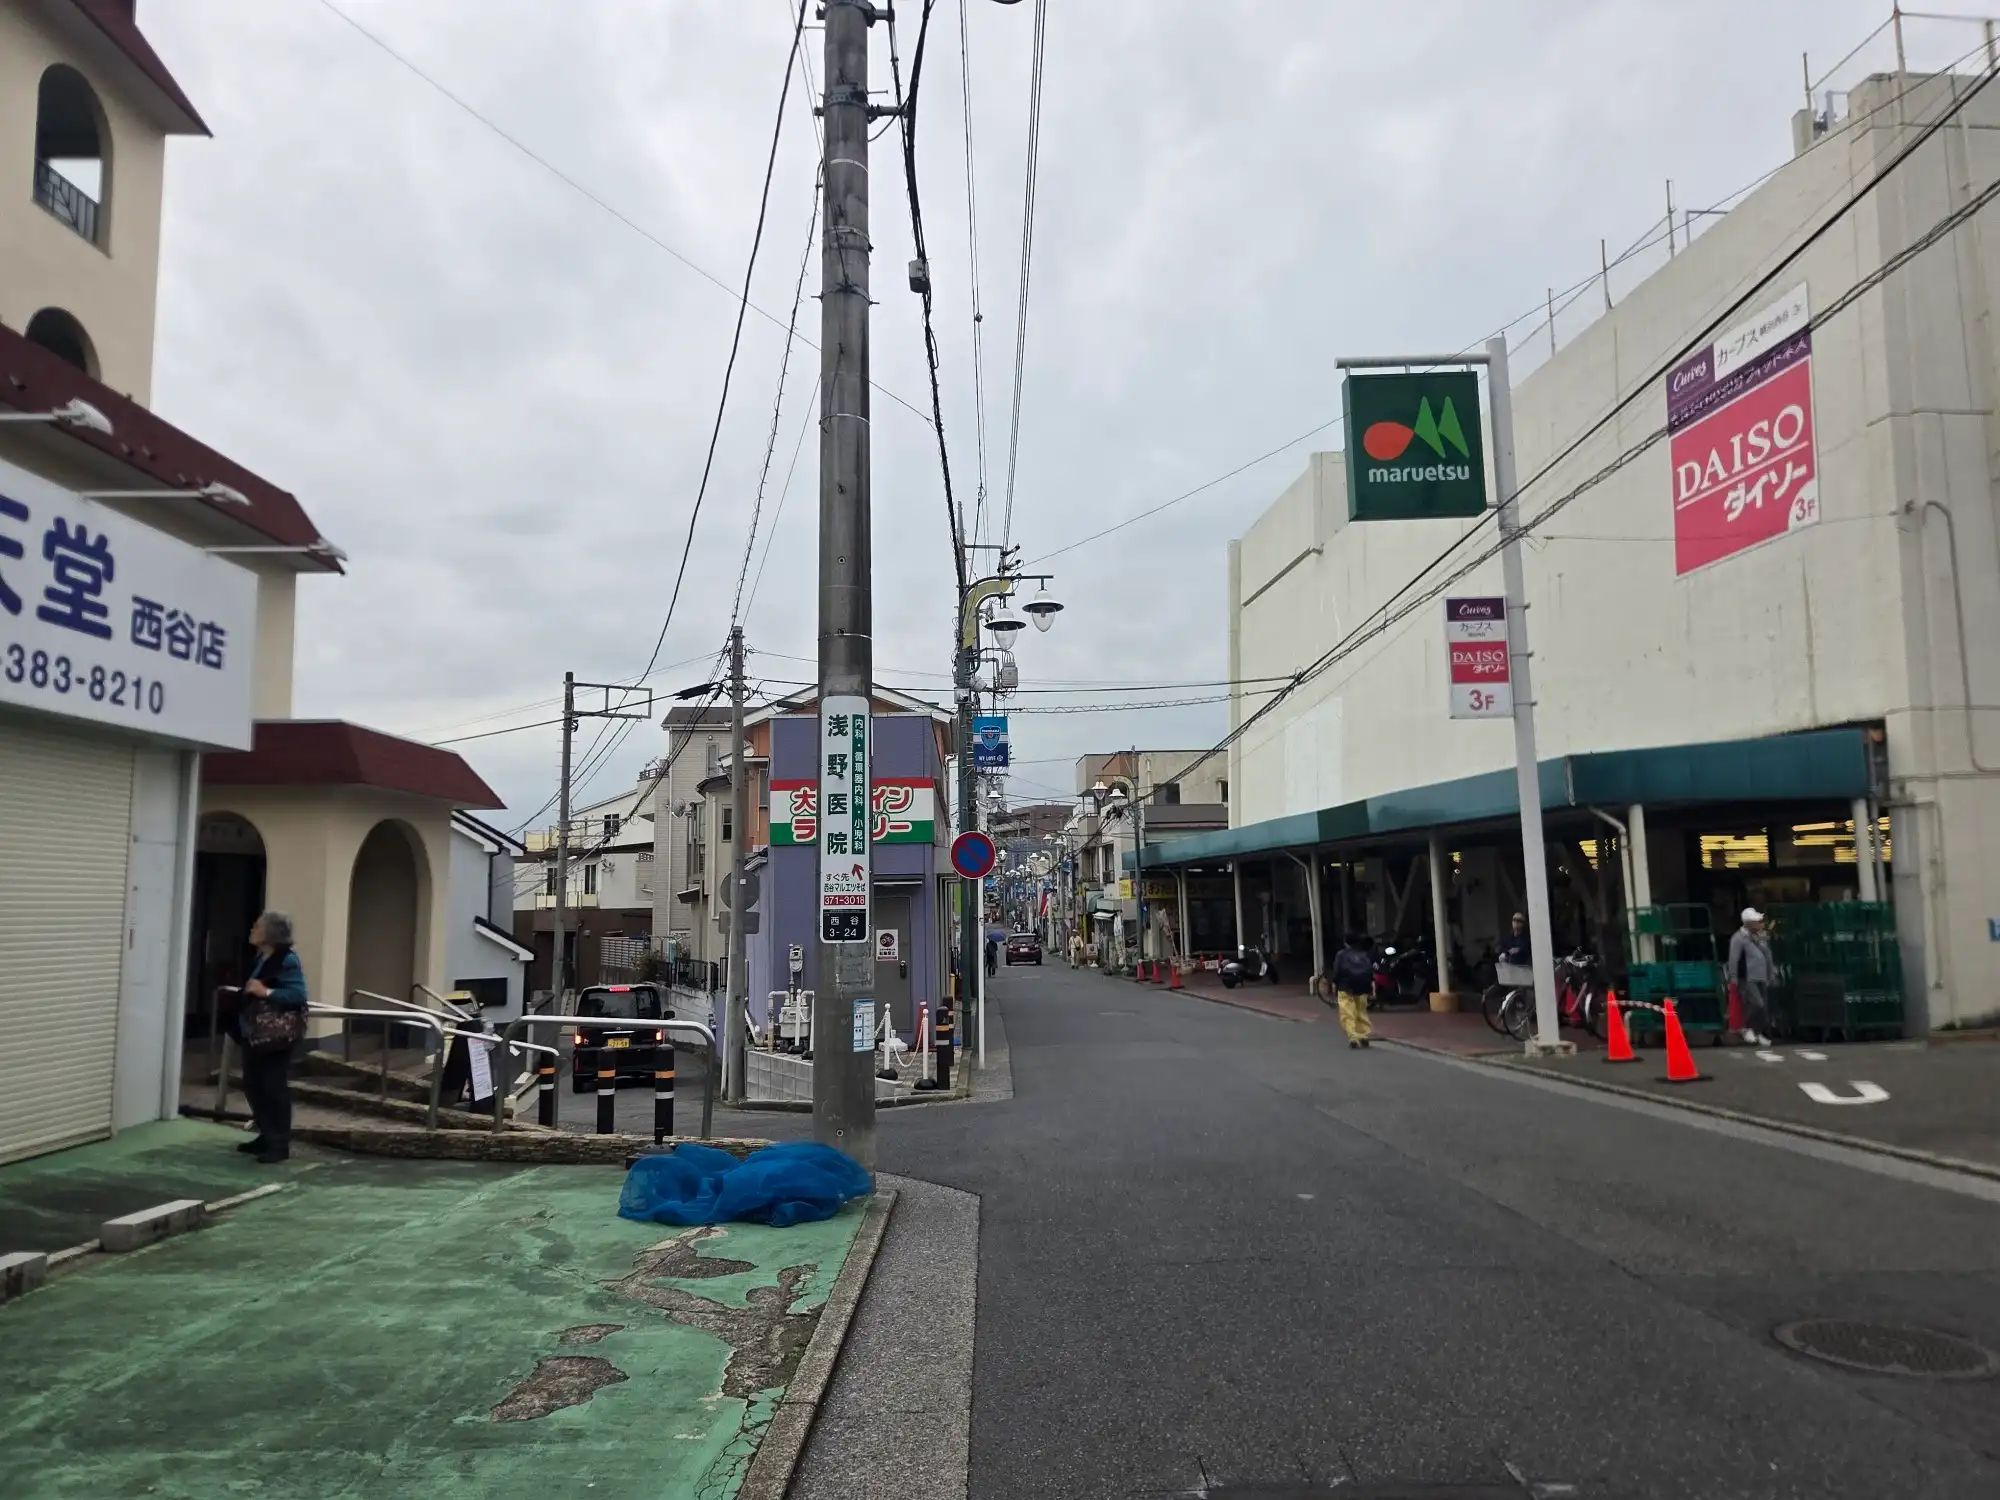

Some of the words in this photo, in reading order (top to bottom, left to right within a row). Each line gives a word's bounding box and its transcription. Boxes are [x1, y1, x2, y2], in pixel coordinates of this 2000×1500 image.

[1677, 404, 1804, 502] DAISO
[1368, 463, 1470, 483] maruetsu
[1723, 460, 1808, 522] ダイソー
[1795, 498, 1816, 521] 3F
[130, 594, 229, 670] 西谷店
[1453, 650, 1504, 663] DAISO
[0, 643, 164, 715] 383-8210
[1469, 689, 1494, 711] 3F
[827, 714, 849, 855] 浅野医院
[826, 873, 850, 881] すぐ先
[824, 896, 865, 905] 371-3018
